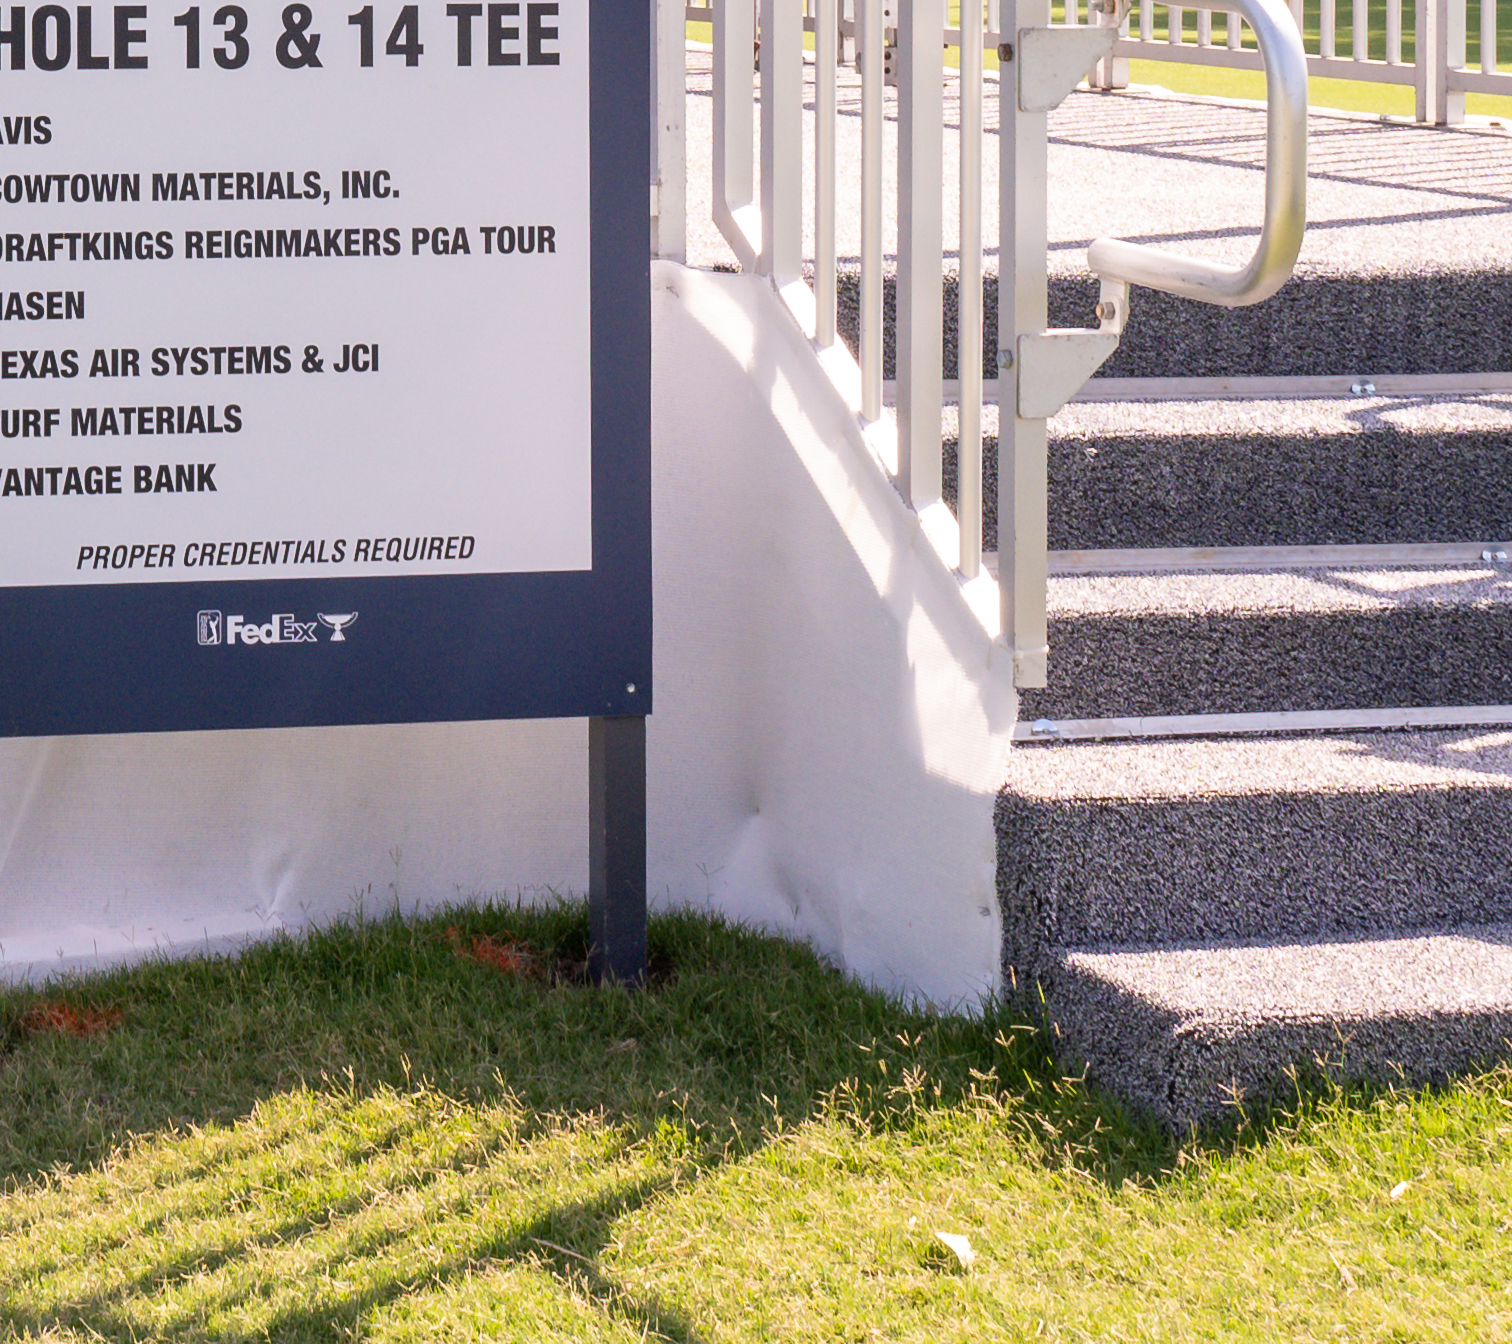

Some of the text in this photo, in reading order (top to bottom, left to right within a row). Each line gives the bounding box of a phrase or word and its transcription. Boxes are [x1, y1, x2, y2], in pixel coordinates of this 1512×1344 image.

[174, 5, 249, 69] 13
[276, 4, 323, 69] &
[348, 5, 423, 67] 14
[447, 3, 560, 66] TEE
[152, 171, 329, 205] MATERIALS,
[342, 170, 399, 198] INC.
[185, 228, 400, 258] REIGNMAKERS
[412, 227, 470, 255] PGA
[480, 226, 555, 254] TOUR
[89, 349, 140, 377] AIR
[152, 346, 291, 376] SYSTEMS
[302, 345, 323, 373] &
[333, 344, 378, 372] JCI
[71, 405, 242, 436] MATERIALS
[134, 464, 217, 493] BANK
[77, 536, 475, 569] PROPER CREDENTIALS REQUIRED
[227, 614, 317, 644] FedEx
